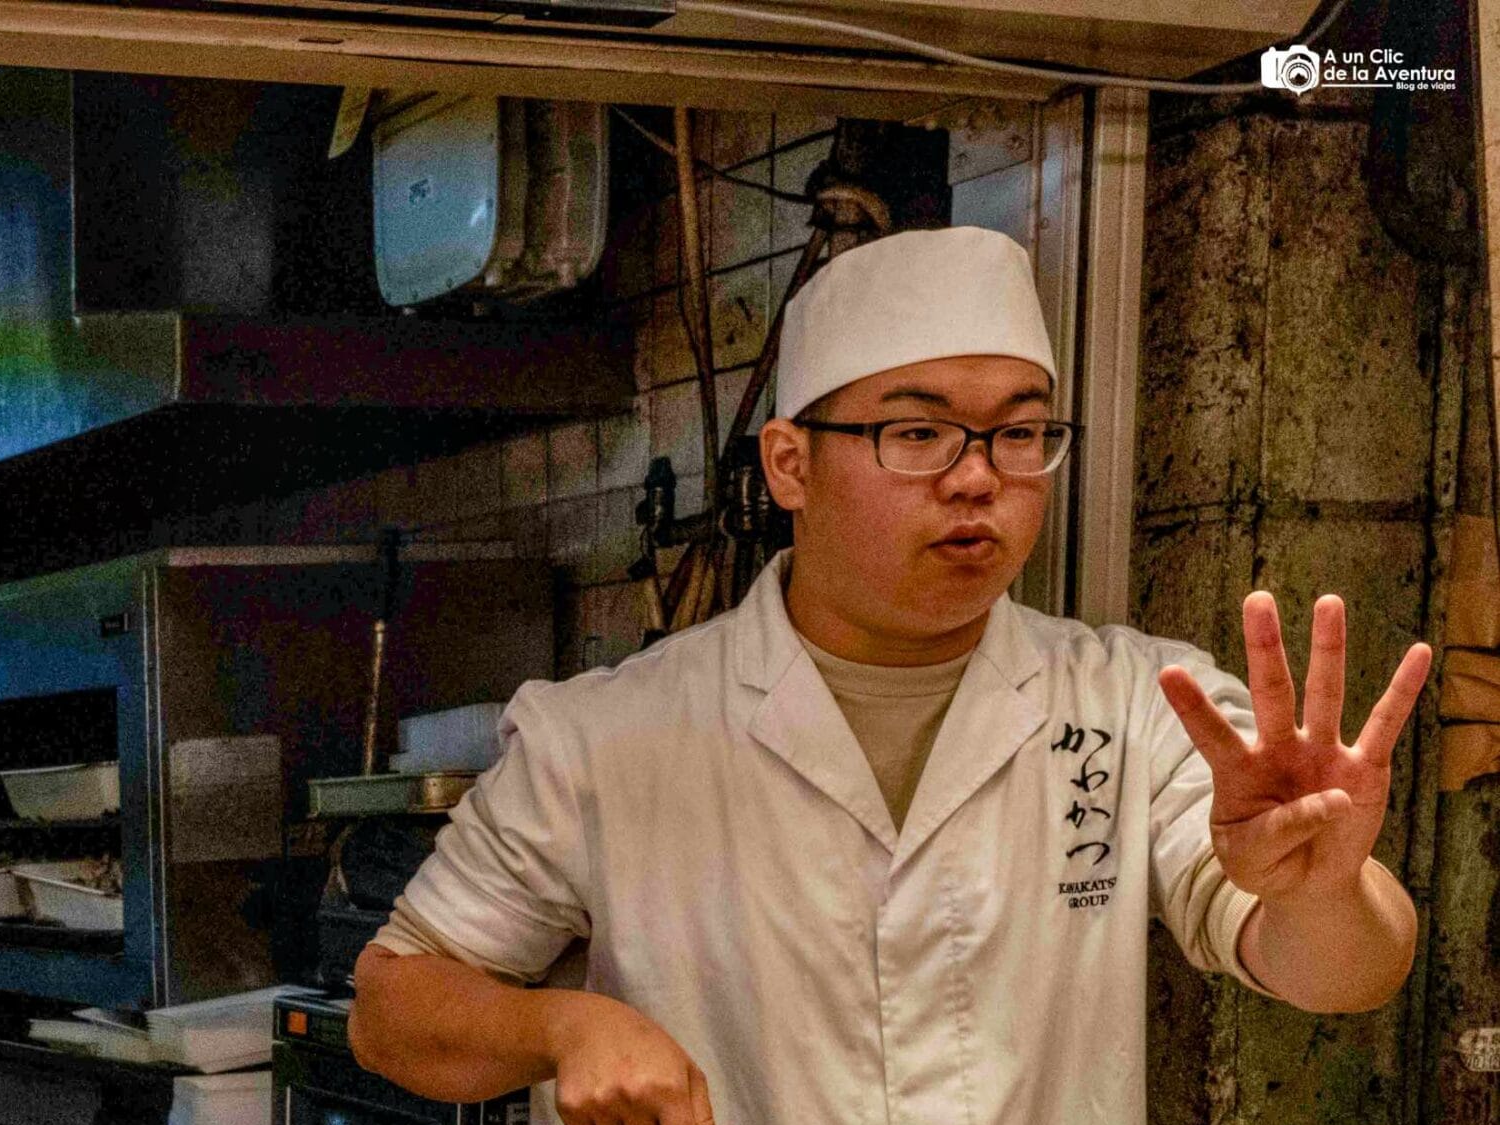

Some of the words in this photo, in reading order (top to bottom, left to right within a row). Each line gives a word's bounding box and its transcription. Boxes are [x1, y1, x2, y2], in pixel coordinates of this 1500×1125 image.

[1051, 722, 1112, 866] かわかつ
[1058, 876, 1118, 894] KAWAKATS
[1068, 894, 1109, 909] GROUP
